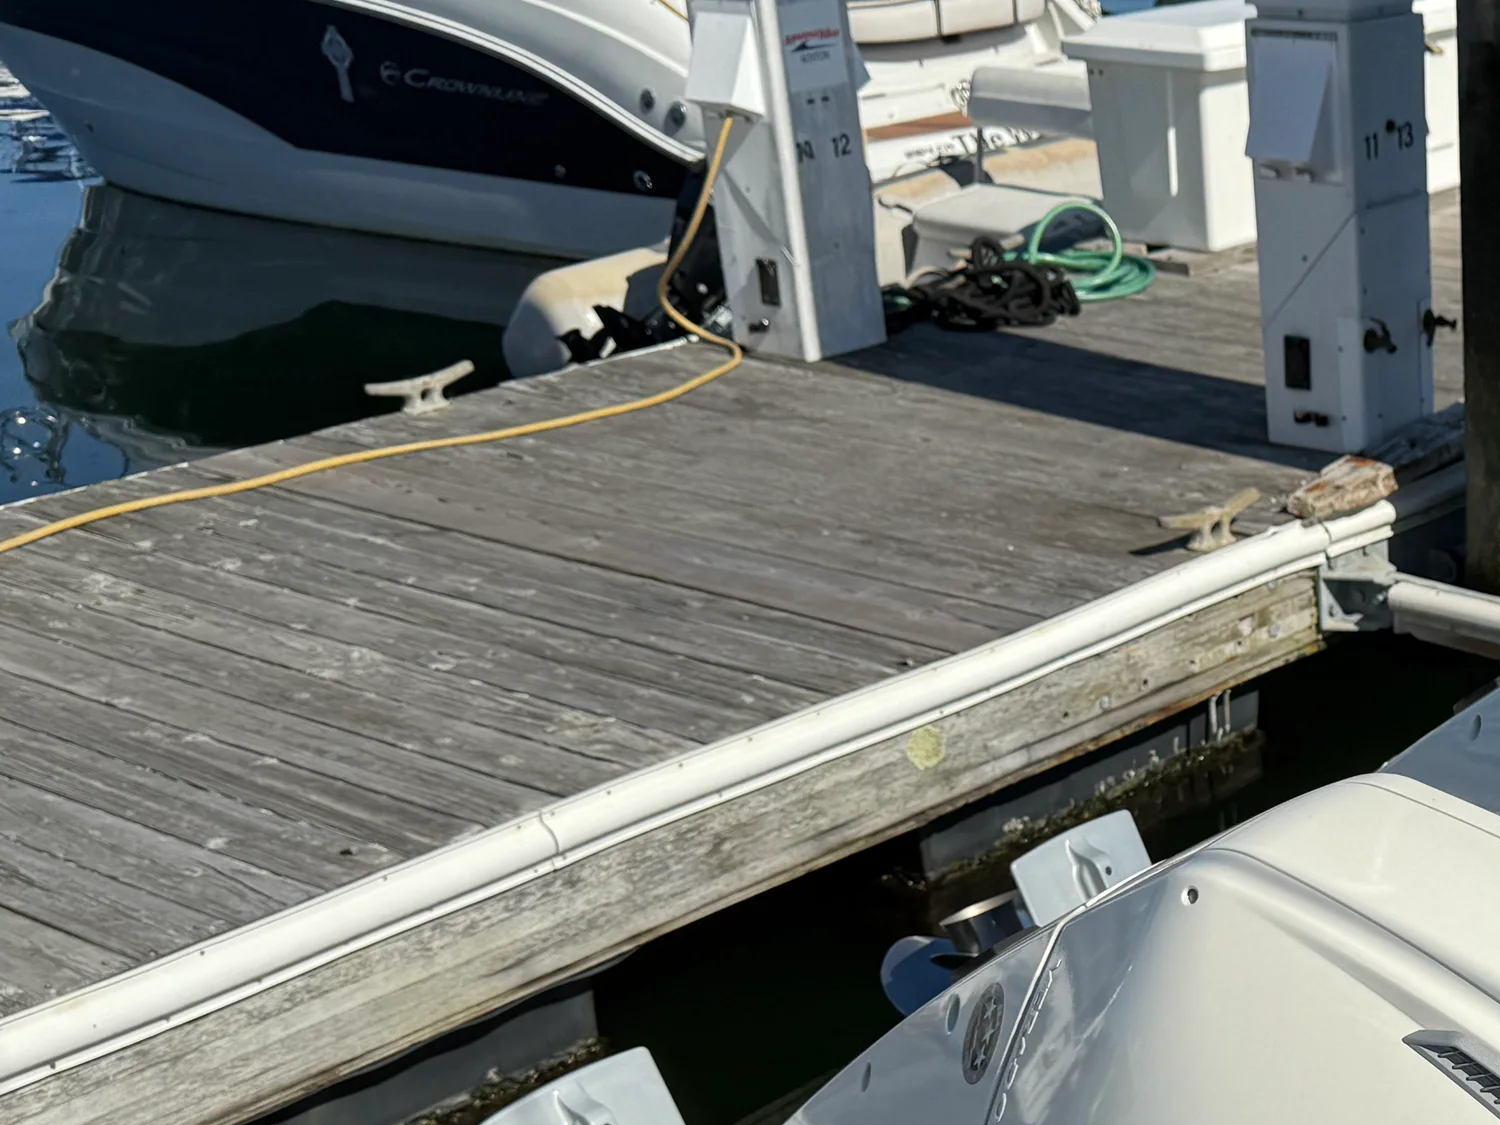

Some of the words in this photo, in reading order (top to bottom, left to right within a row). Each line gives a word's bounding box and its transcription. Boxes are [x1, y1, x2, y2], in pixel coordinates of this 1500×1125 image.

[831, 133, 853, 158] 12
[1364, 133, 1379, 161] 11
[1397, 121, 1414, 151] 13
